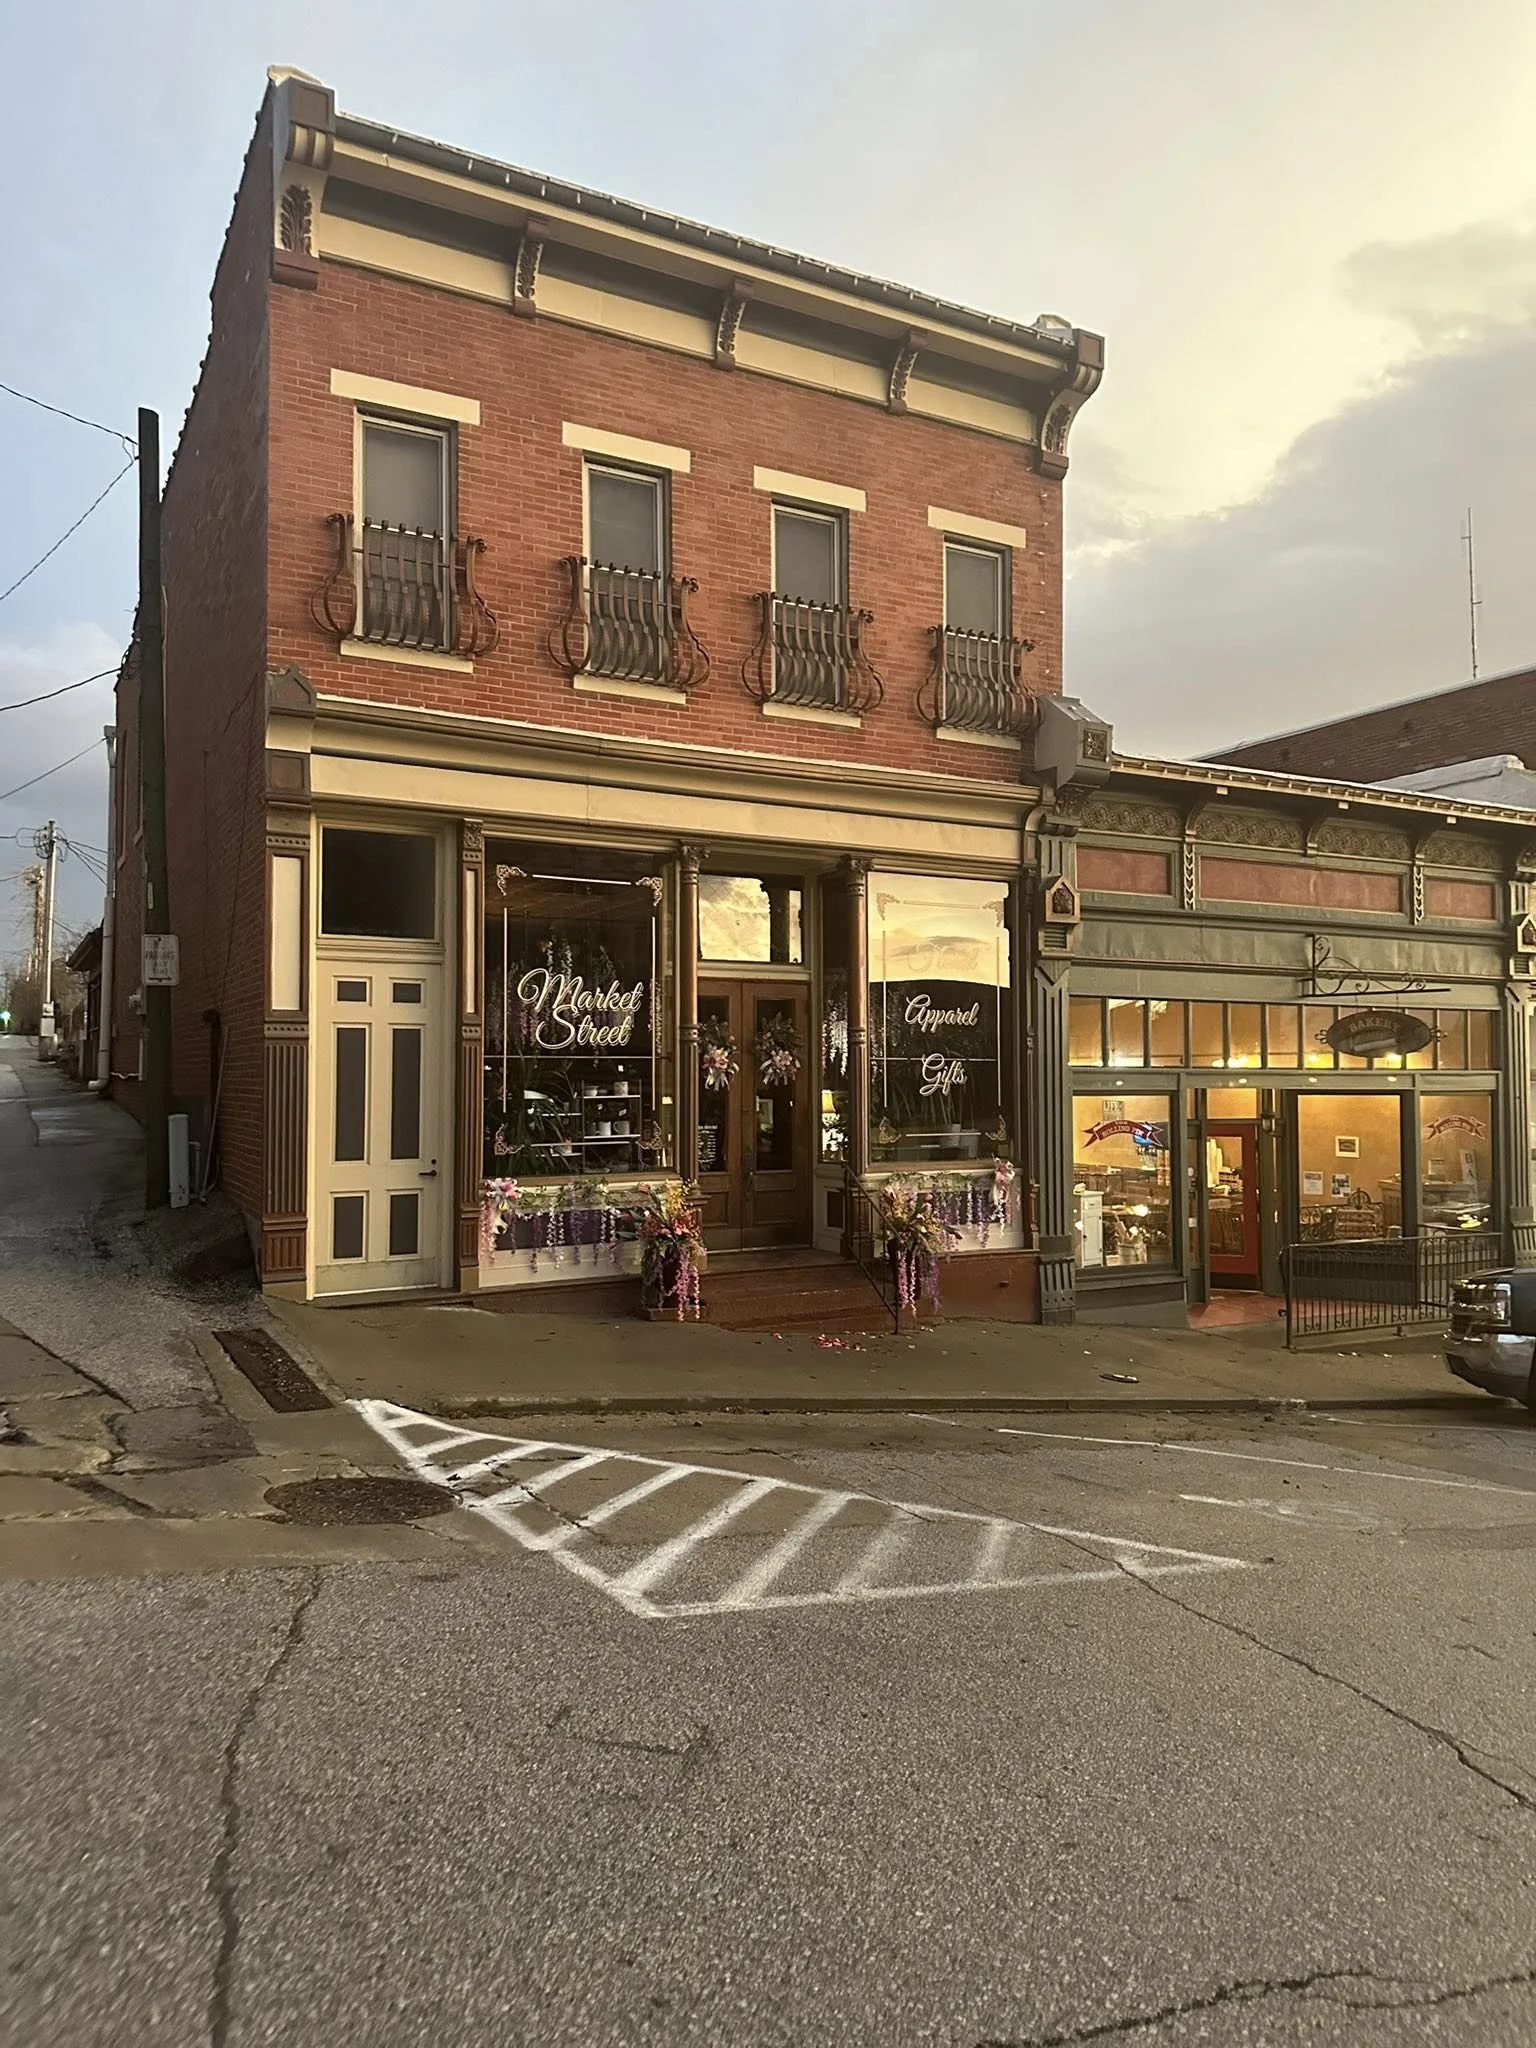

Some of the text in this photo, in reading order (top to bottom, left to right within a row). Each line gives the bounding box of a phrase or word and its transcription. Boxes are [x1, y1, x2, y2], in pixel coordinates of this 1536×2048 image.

[517, 968, 644, 1012] Market
[536, 1004, 632, 1049] Street
[904, 993, 980, 1033] Apparel
[1348, 1016, 1401, 1033] BAKERY
[919, 1053, 967, 1096] Gifts
[1102, 1126, 1130, 1138] ROLLING
